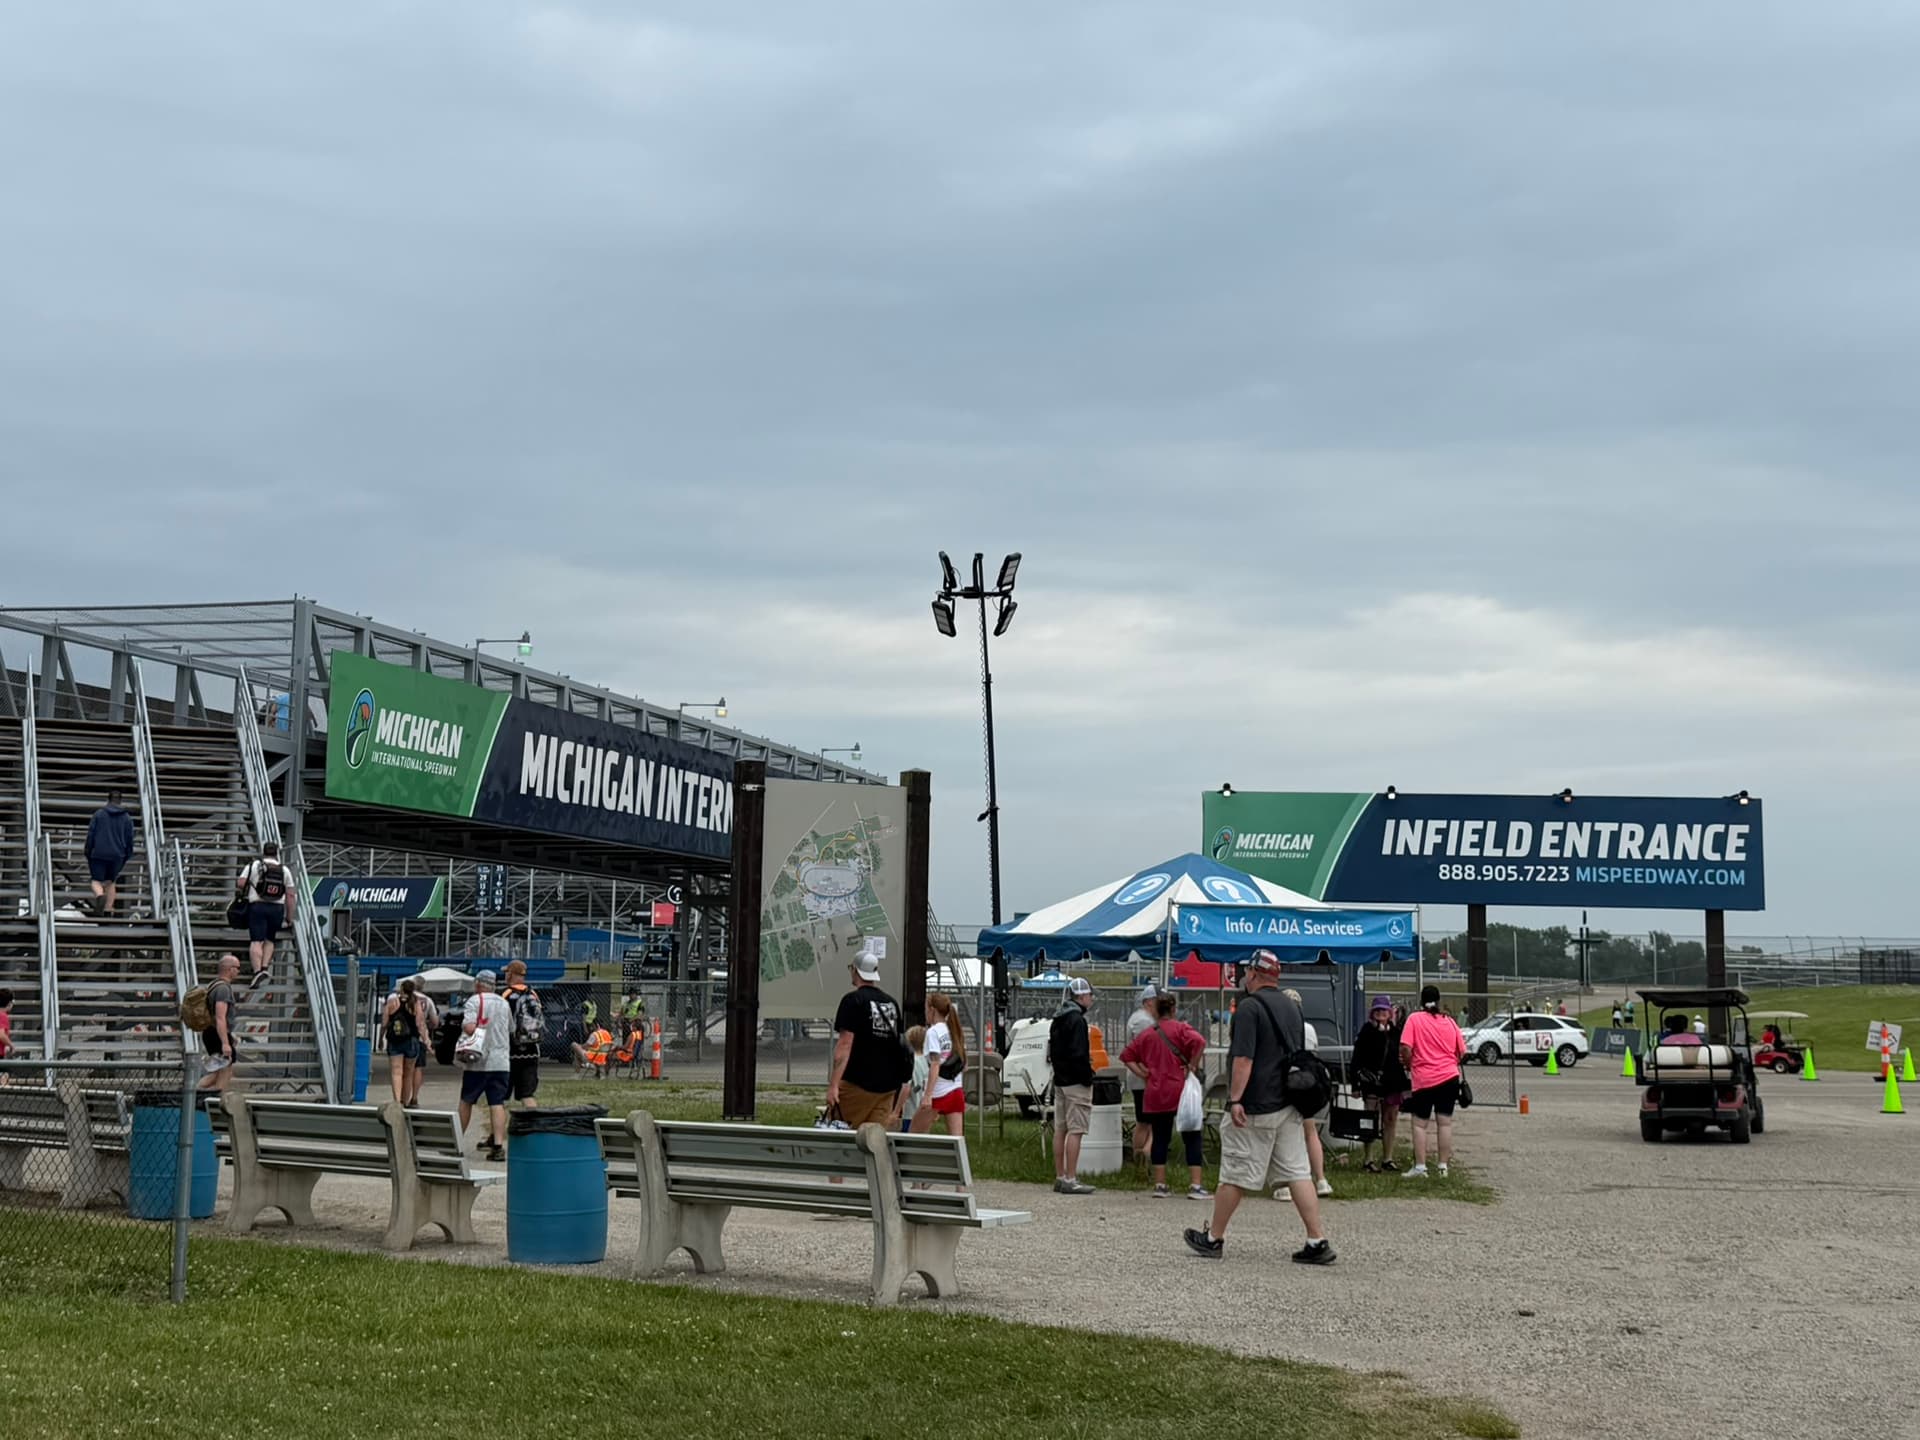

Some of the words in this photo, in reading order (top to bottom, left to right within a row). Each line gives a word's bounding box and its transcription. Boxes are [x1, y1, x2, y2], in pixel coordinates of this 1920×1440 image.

[375, 708, 463, 759] MICHIGAN
[371, 751, 423, 773] INTERNATIONAL
[424, 760, 457, 777] SPEEDWAY
[519, 731, 655, 818] MICHIGAN
[1235, 833, 1315, 851] MICHIGAN
[1382, 819, 1533, 858] INFIELD
[1539, 821, 1750, 862] ENTRANCE
[1233, 851, 1277, 859] INTERNATIONAL
[1438, 864, 1570, 882] 888.905.7223
[1575, 866, 1746, 886] MISPEEDWAY.COM
[348, 888, 409, 903] MICHIGAN
[1225, 916, 1254, 933] Info
[1267, 918, 1301, 935] ADA
[1303, 919, 1364, 936] Services
